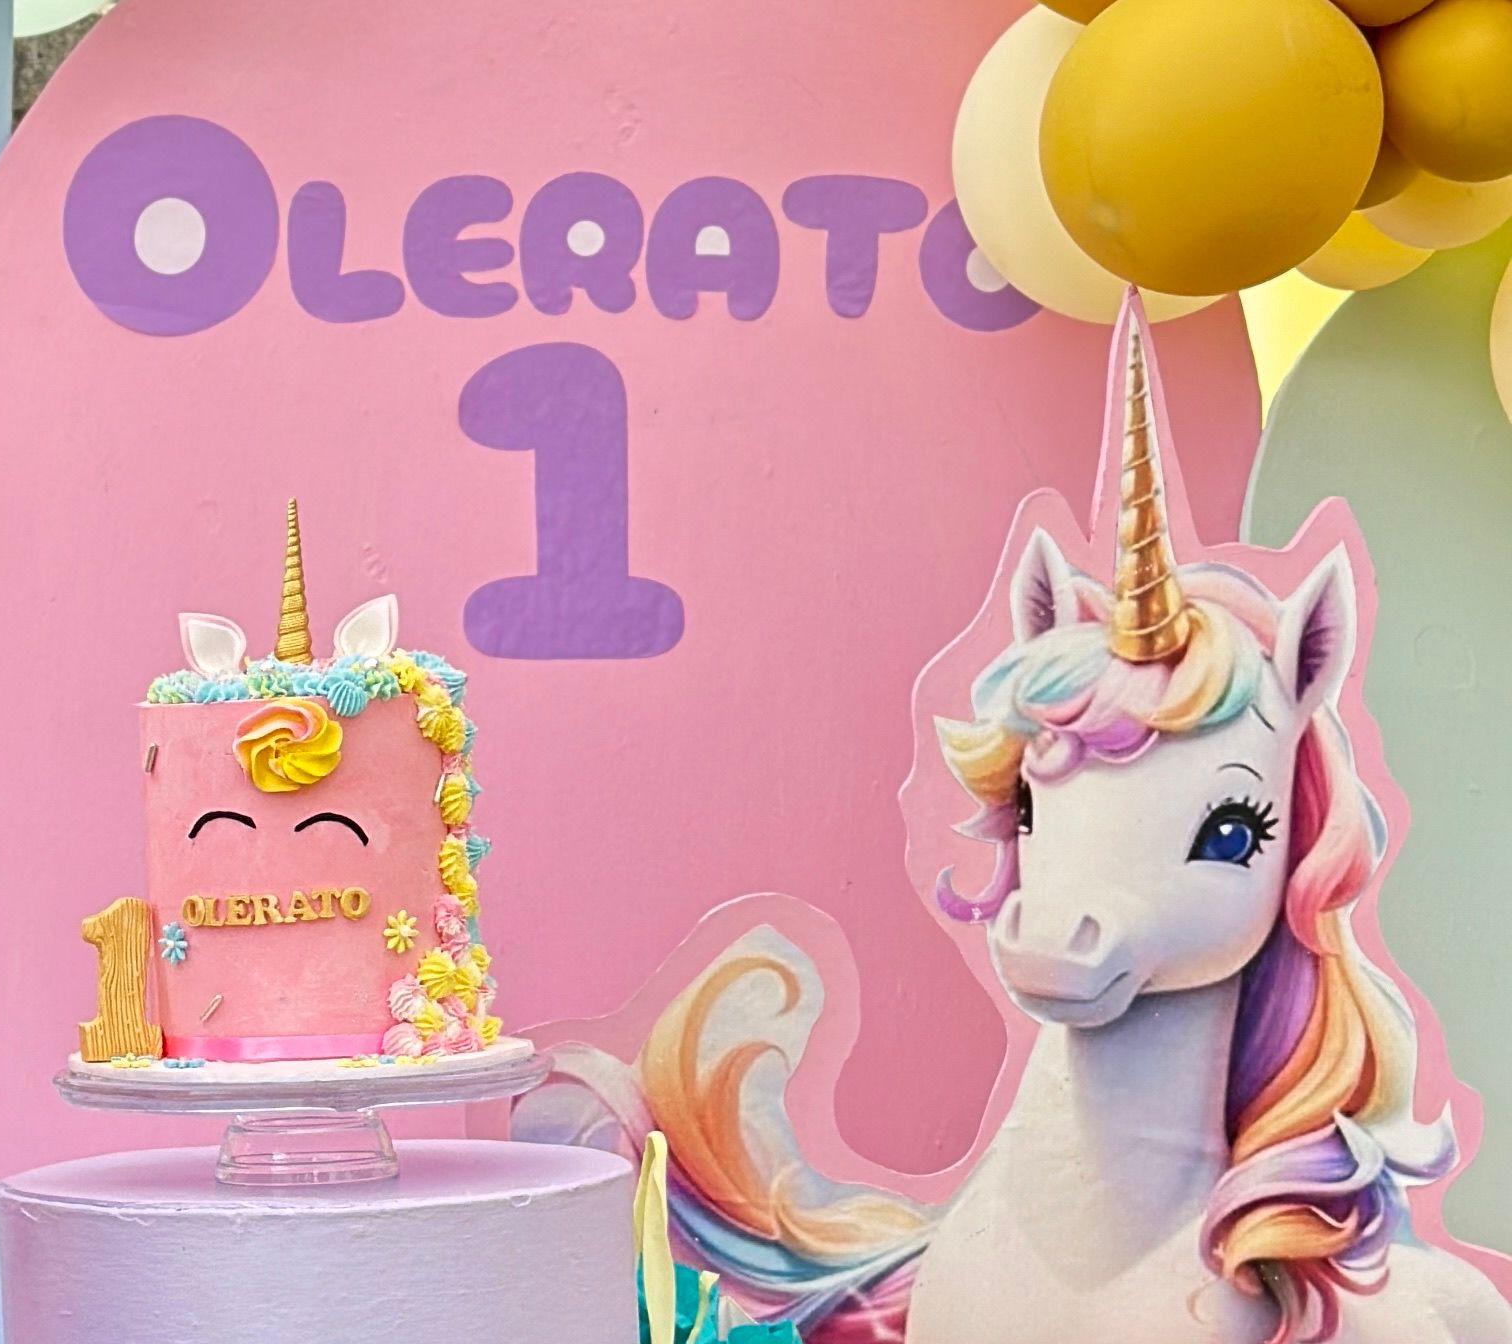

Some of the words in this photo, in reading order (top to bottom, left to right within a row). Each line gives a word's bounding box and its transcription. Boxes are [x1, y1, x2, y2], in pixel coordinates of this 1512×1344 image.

[458, 342, 684, 659] 1
[79, 897, 164, 1062] 1
[182, 887, 371, 927] OLERATO
